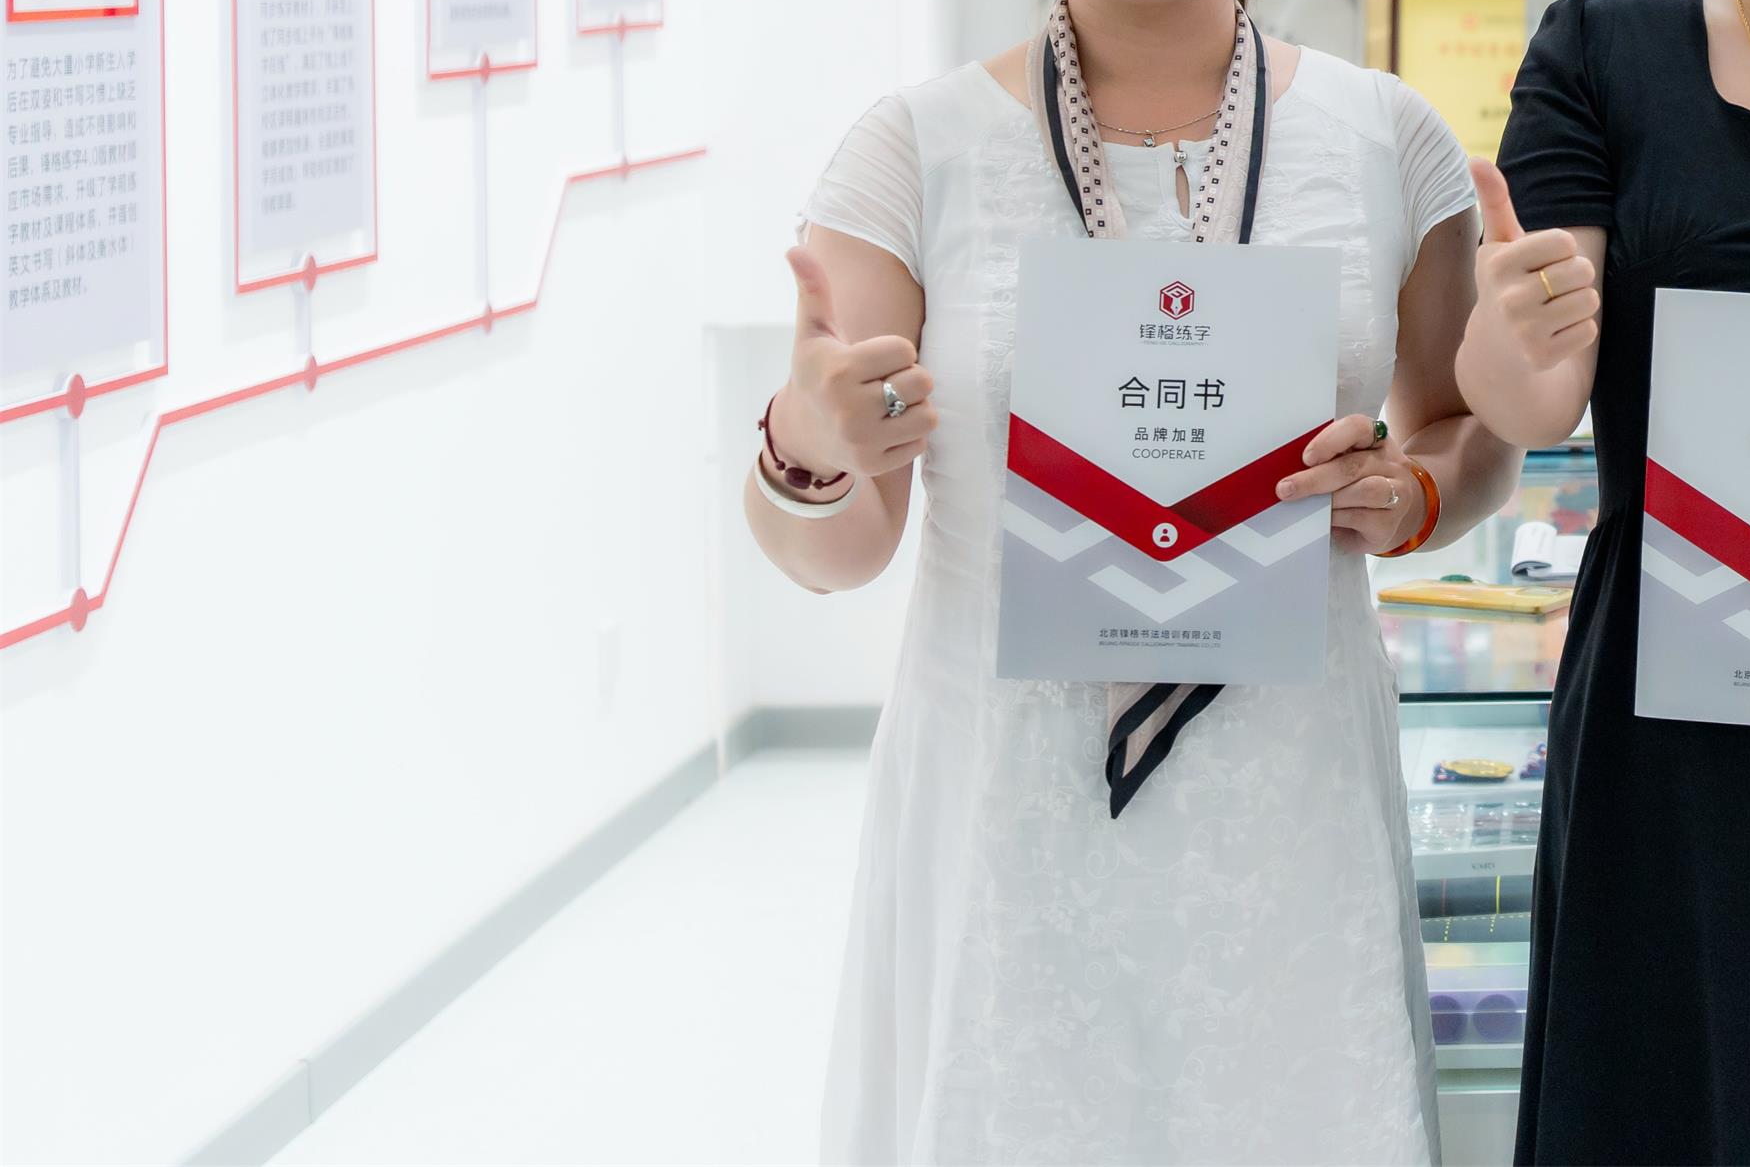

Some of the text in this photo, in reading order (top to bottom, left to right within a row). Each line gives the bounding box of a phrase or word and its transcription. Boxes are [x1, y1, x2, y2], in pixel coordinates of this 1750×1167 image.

[1139, 324, 1211, 341] 锋格练字
[1118, 376, 1225, 411] 合同书
[1134, 427, 1206, 444] 品牌加盟
[1132, 448, 1205, 460] COOPERATE
[1099, 628, 1221, 640] 北京锋格书法培训有限公司
